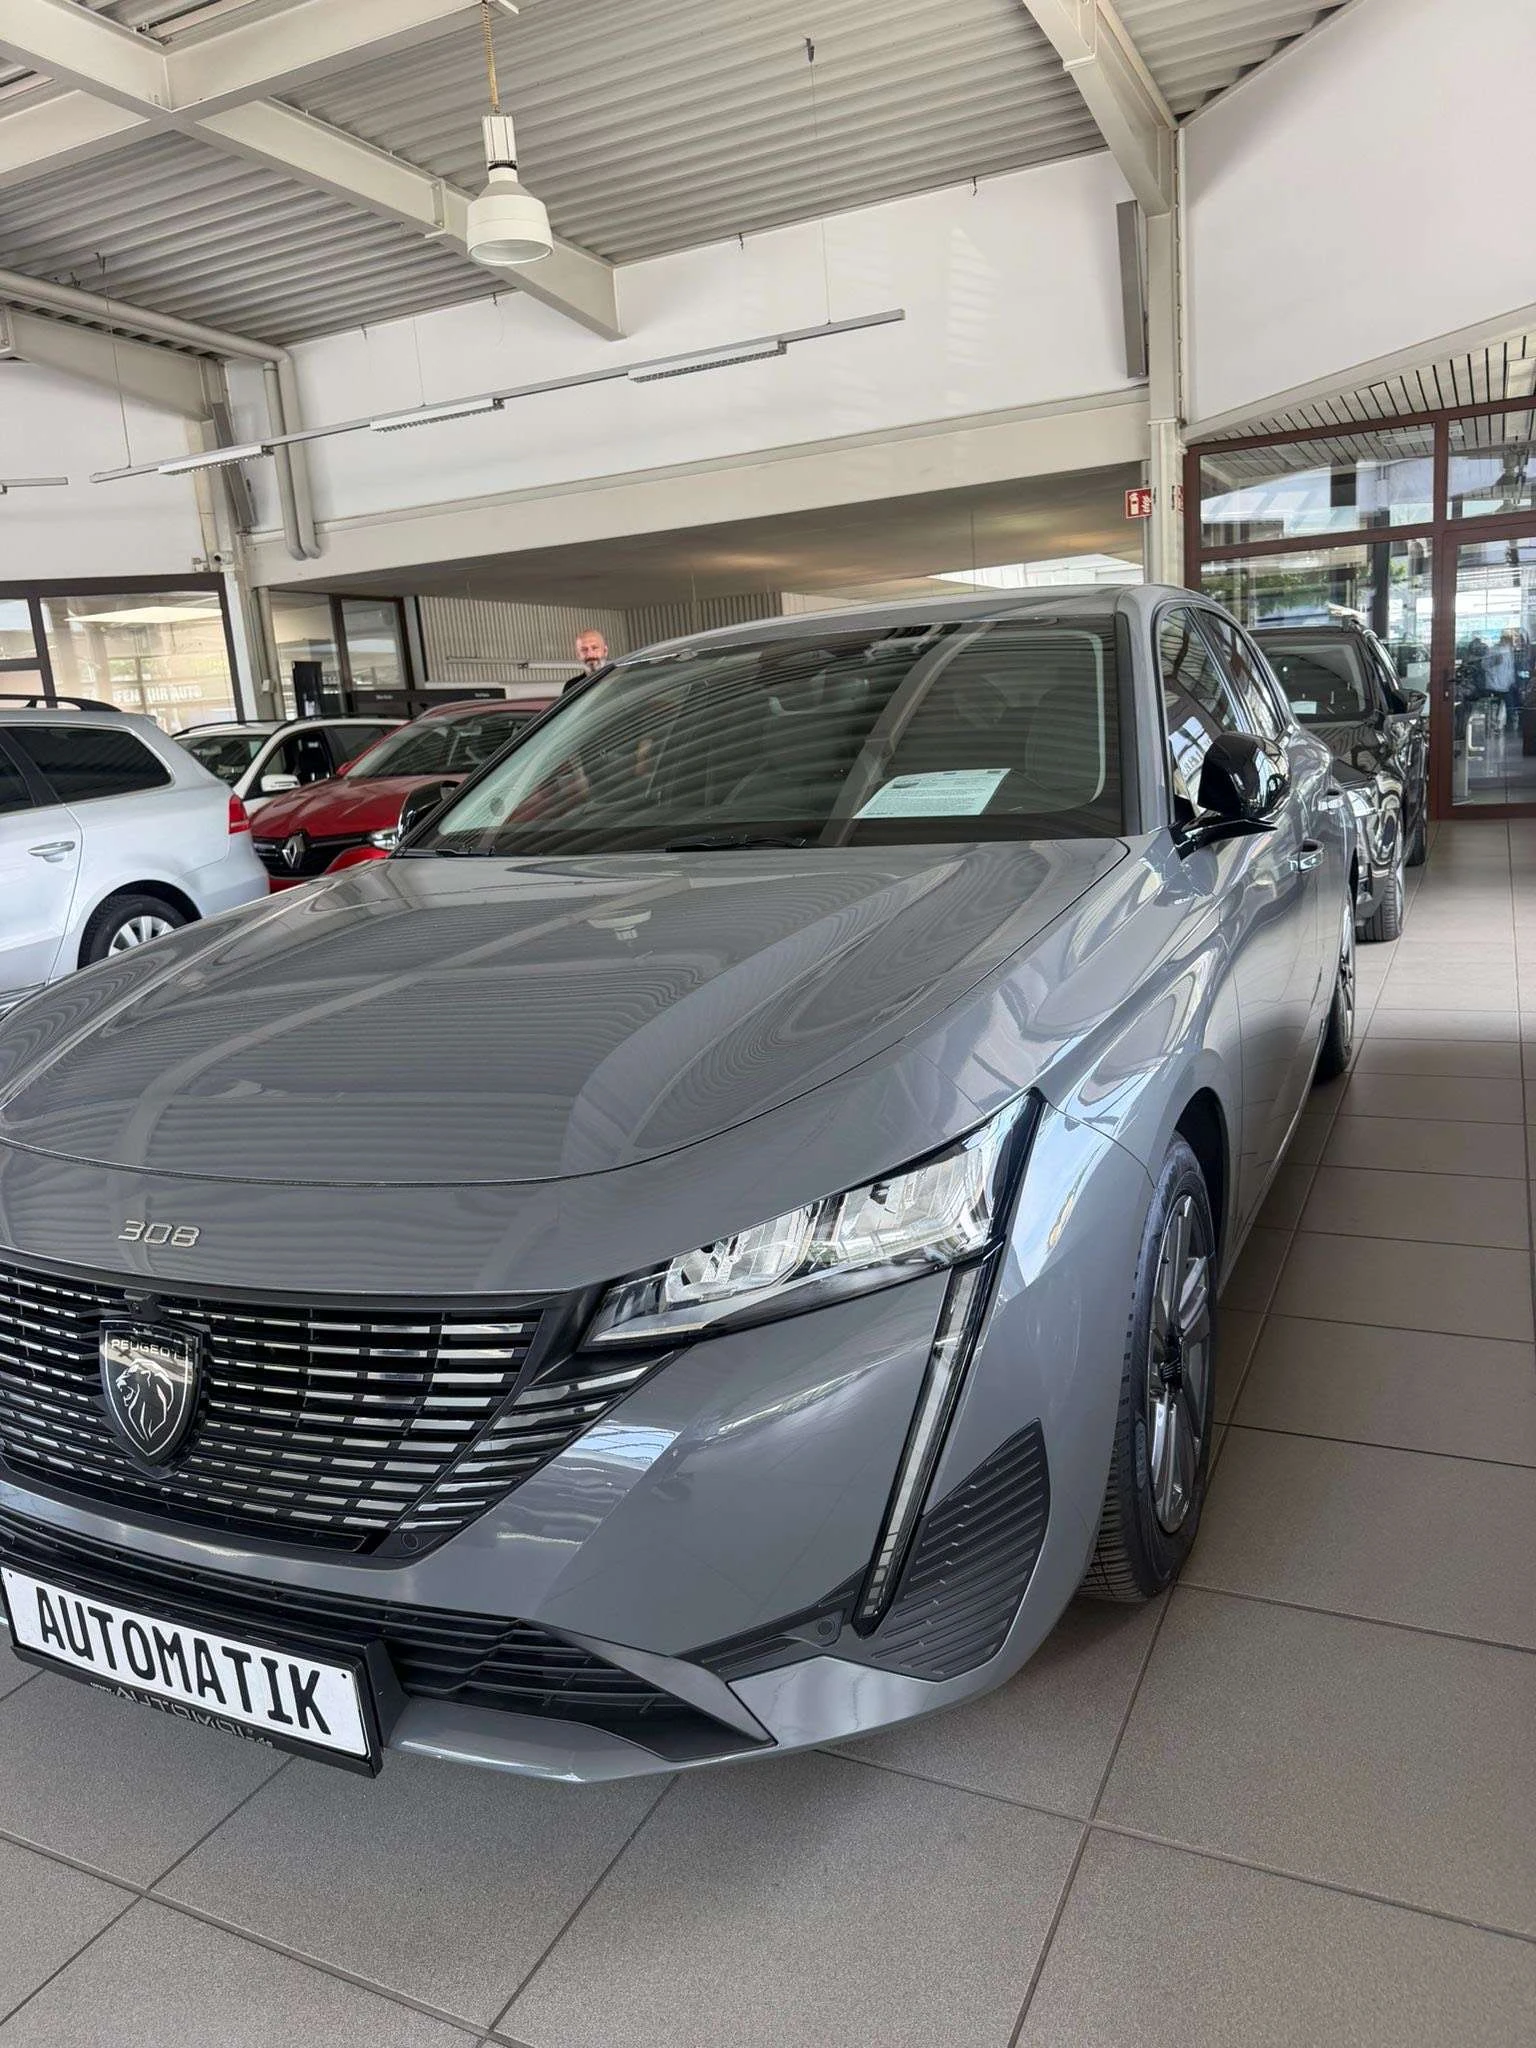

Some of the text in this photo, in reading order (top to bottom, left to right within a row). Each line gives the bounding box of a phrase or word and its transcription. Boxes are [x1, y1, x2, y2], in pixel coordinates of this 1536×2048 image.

[118, 1219, 200, 1248] 308
[111, 1338, 179, 1360] PEUGEOT
[36, 1586, 332, 1736] AUTOMATIK
